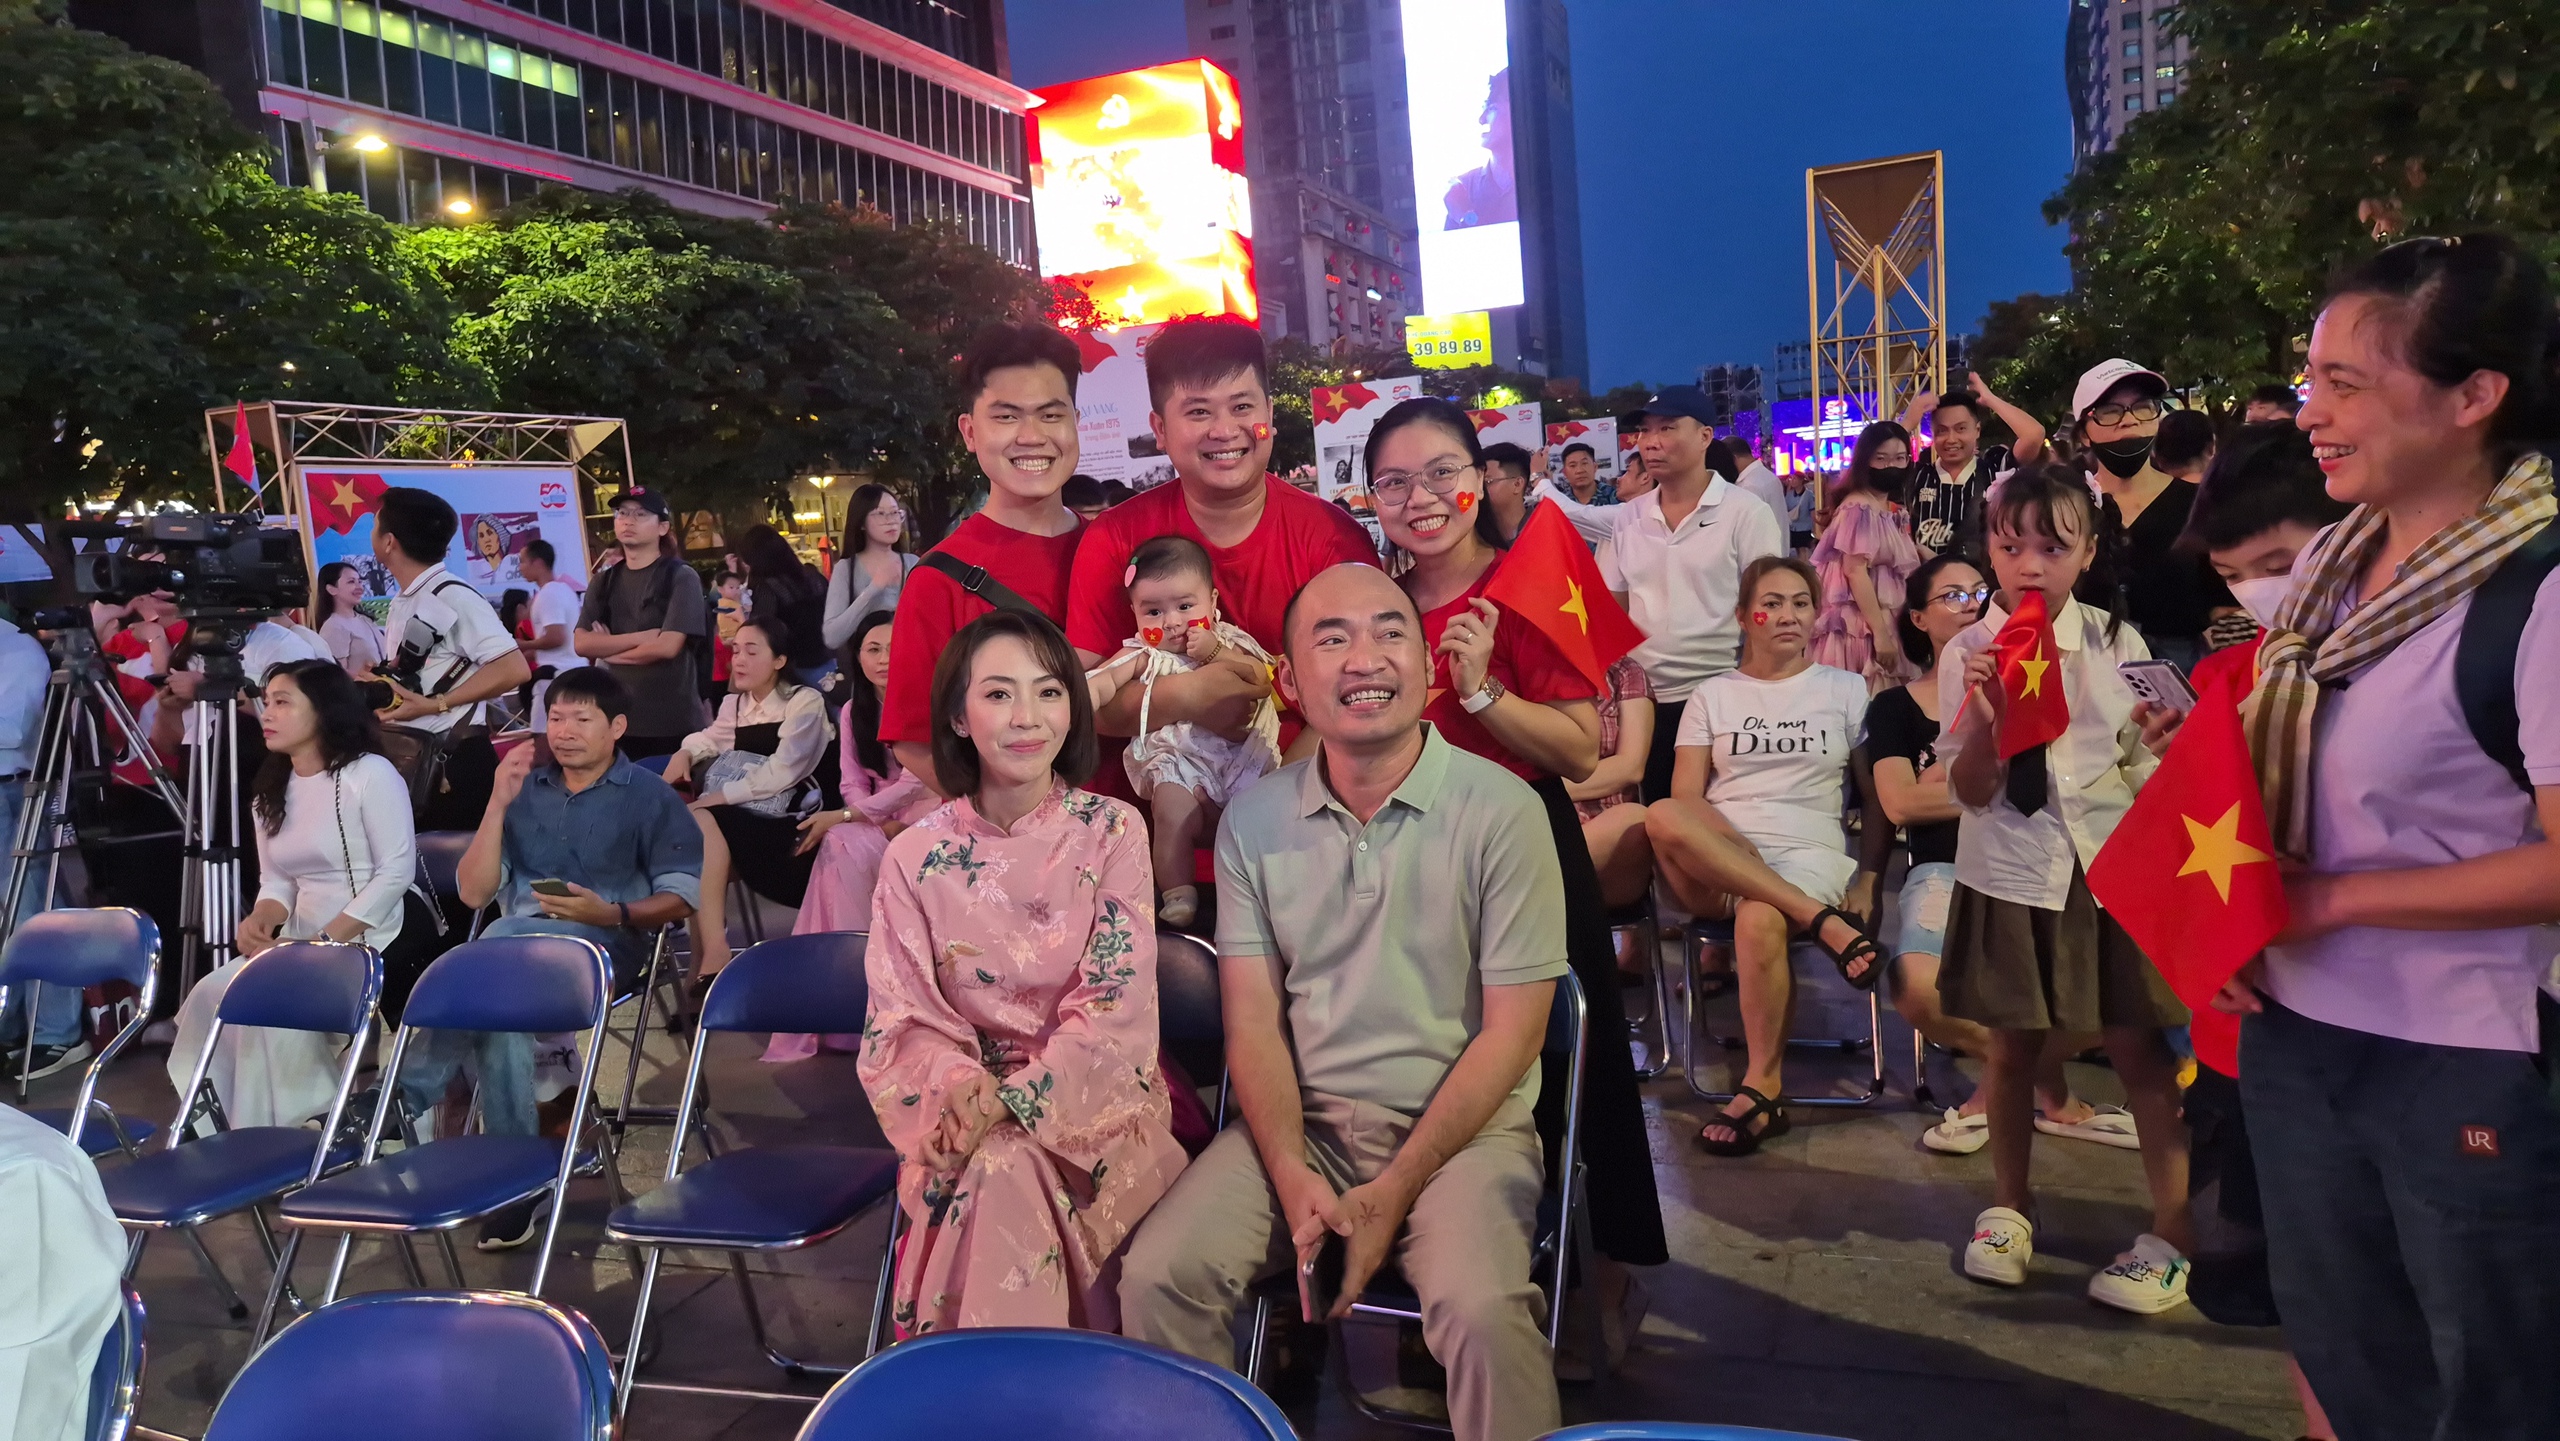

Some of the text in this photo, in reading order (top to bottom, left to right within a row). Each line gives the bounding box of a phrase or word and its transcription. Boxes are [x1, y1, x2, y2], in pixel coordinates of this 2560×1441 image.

[1743, 716, 1807, 733] Oh my
[1728, 730, 1828, 756] Dior!
